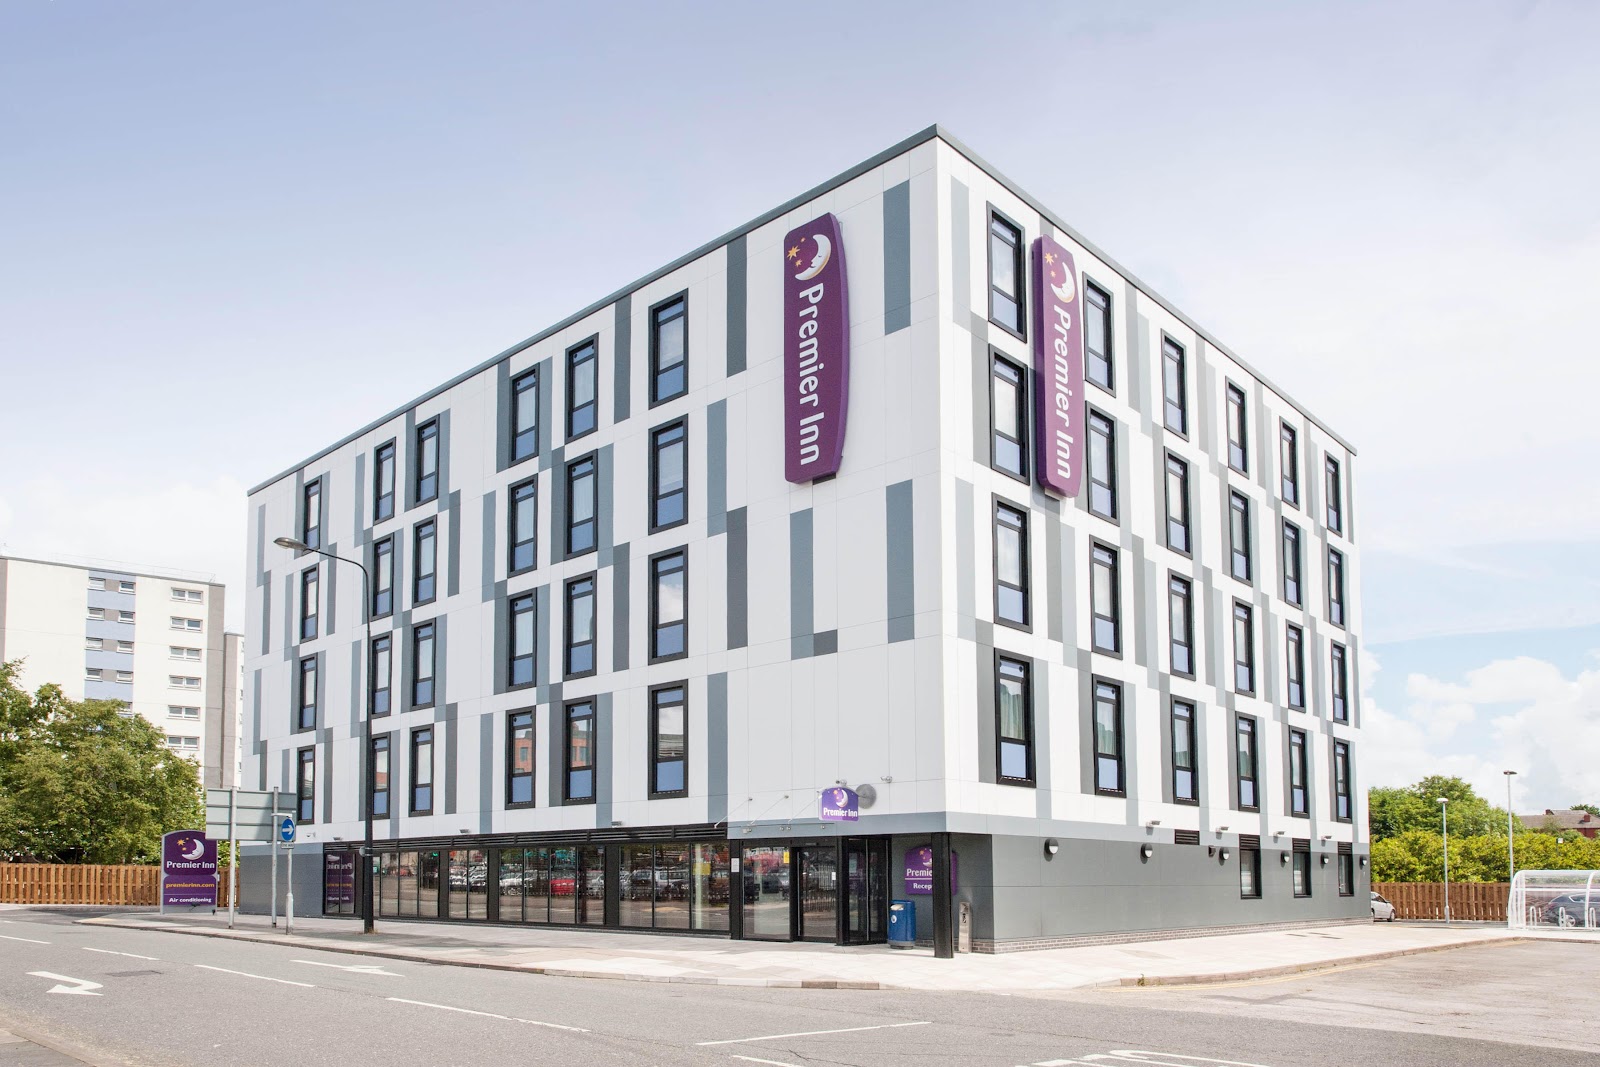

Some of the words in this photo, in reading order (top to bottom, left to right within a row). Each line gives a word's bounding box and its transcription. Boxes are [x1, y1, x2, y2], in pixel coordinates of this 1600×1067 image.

[799, 283, 824, 407] Premier
[1054, 304, 1072, 427] Premier
[800, 412, 825, 465] Inn
[1056, 430, 1074, 479] Inn
[823, 807, 847, 816] Premier
[848, 809, 858, 817] Inn
[906, 868, 933, 876] Premie
[913, 882, 933, 890] Recep
